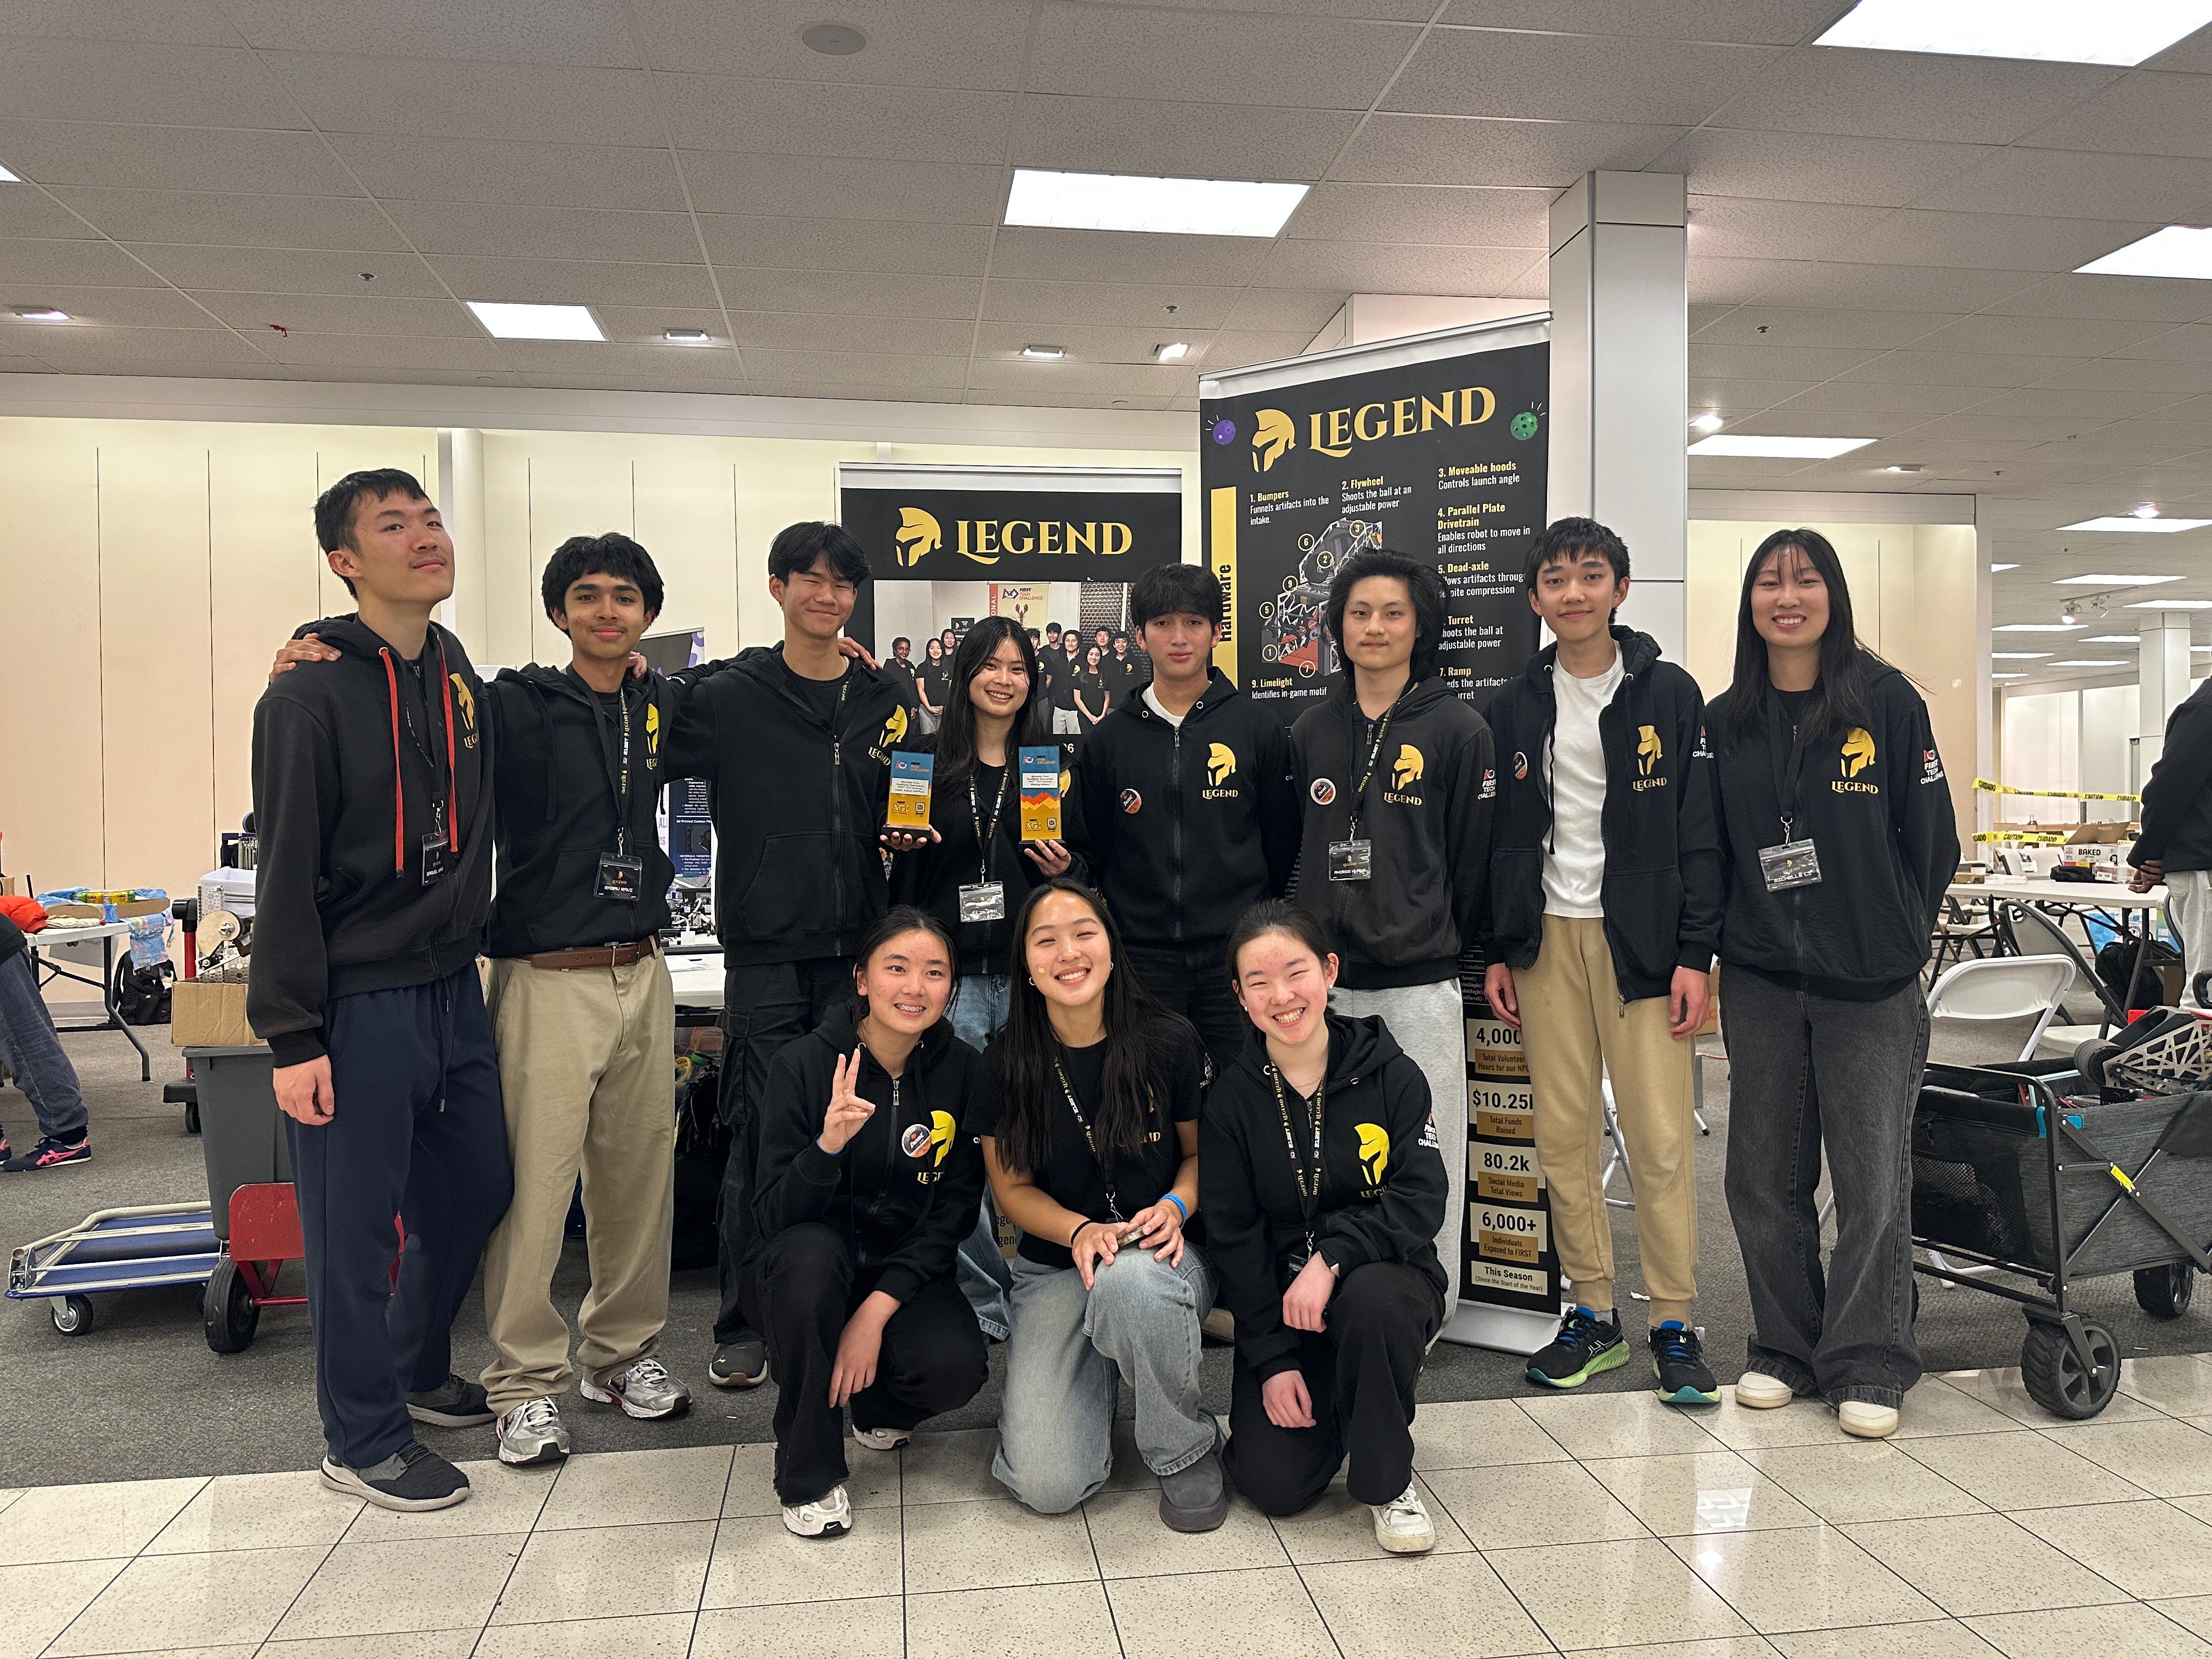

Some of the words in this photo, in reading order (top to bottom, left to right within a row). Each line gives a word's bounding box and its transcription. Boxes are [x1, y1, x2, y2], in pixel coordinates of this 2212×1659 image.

[1308, 386, 1496, 458] LEGEND
[1438, 468, 1446, 478] 3.
[1448, 464, 1488, 476] Moveable
[1491, 461, 1516, 472] hoods
[1342, 481, 1348, 490] 2.
[1351, 476, 1384, 489] Flywheel
[1438, 478, 1469, 490] Controls
[1471, 475, 1496, 486] launch
[1499, 473, 1520, 484] angle
[1250, 494, 1256, 503] 1.
[1257, 491, 1289, 502] Bumpers
[1342, 492, 1364, 501] Shoots
[1366, 489, 1377, 499] the
[1379, 487, 1392, 497] ball
[1394, 486, 1401, 495] at
[1250, 503, 1274, 514] Funnels
[1276, 499, 1301, 511] artifacts
[1304, 498, 1316, 506] into
[1318, 496, 1329, 505] the
[1342, 501, 1375, 514] adjustable
[1378, 500, 1400, 511] power
[1437, 508, 1445, 517] 4.
[1448, 504, 1480, 516] Parallel
[1482, 504, 1505, 513] Plate
[1250, 516, 1271, 526] intake.
[1438, 517, 1479, 530] Drivetrain
[1438, 531, 1465, 542] Enables
[1467, 529, 1488, 539] robot
[1490, 528, 1498, 537] to
[1500, 528, 1521, 537] move
[1523, 526, 1530, 535] in
[955, 520, 1132, 565] LEGEND
[1437, 544, 1446, 554] all
[1448, 542, 1486, 553] directions
[1438, 565, 1445, 573] 5.
[1447, 561, 1489, 573] Dead-axle
[1463, 574, 1496, 584] artifacts
[1466, 585, 1515, 597] compression
[1448, 615, 1474, 625] Turret
[1441, 628, 1462, 638] hoots
[1465, 627, 1477, 636] the
[1479, 626, 1493, 635] ball
[1496, 626, 1503, 635] at
[1438, 639, 1475, 651] adjustable
[1477, 640, 1501, 650] power
[1440, 668, 1446, 677] 7.
[1448, 667, 1471, 676] Ramp
[1252, 680, 1259, 688] 9.
[1261, 678, 1293, 688] Limelight
[1462, 678, 1474, 688] the
[1252, 690, 1280, 699] Identifies
[1282, 689, 1307, 698] in-game
[1309, 687, 1327, 696] motif
[1063, 743, 1074, 753] 6
[1831, 781, 1878, 794] LEGEND
[1202, 789, 1238, 799] LEGEND
[1384, 792, 1422, 805] LEGEND
[1478, 1062, 1494, 1071] Hours
[1505, 1117, 1522, 1125] Funds
[1497, 1126, 1515, 1135] Raised
[1484, 1153, 1530, 1171] 80.2k
[1298, 1175, 1308, 1197] LEGEND
[1488, 1177, 1505, 1186] Social
[1506, 1180, 1524, 1188] Media
[1490, 1187, 1504, 1195] Total
[1505, 1189, 1522, 1197] Views
[1482, 1211, 1536, 1231] 6,000+
[1492, 1235, 1522, 1247] Individuals
[1484, 1244, 1506, 1255] Exposed
[1515, 1249, 1532, 1257] FIRST
[1485, 1266, 1502, 1277] This
[1503, 1270, 1532, 1282] Season
